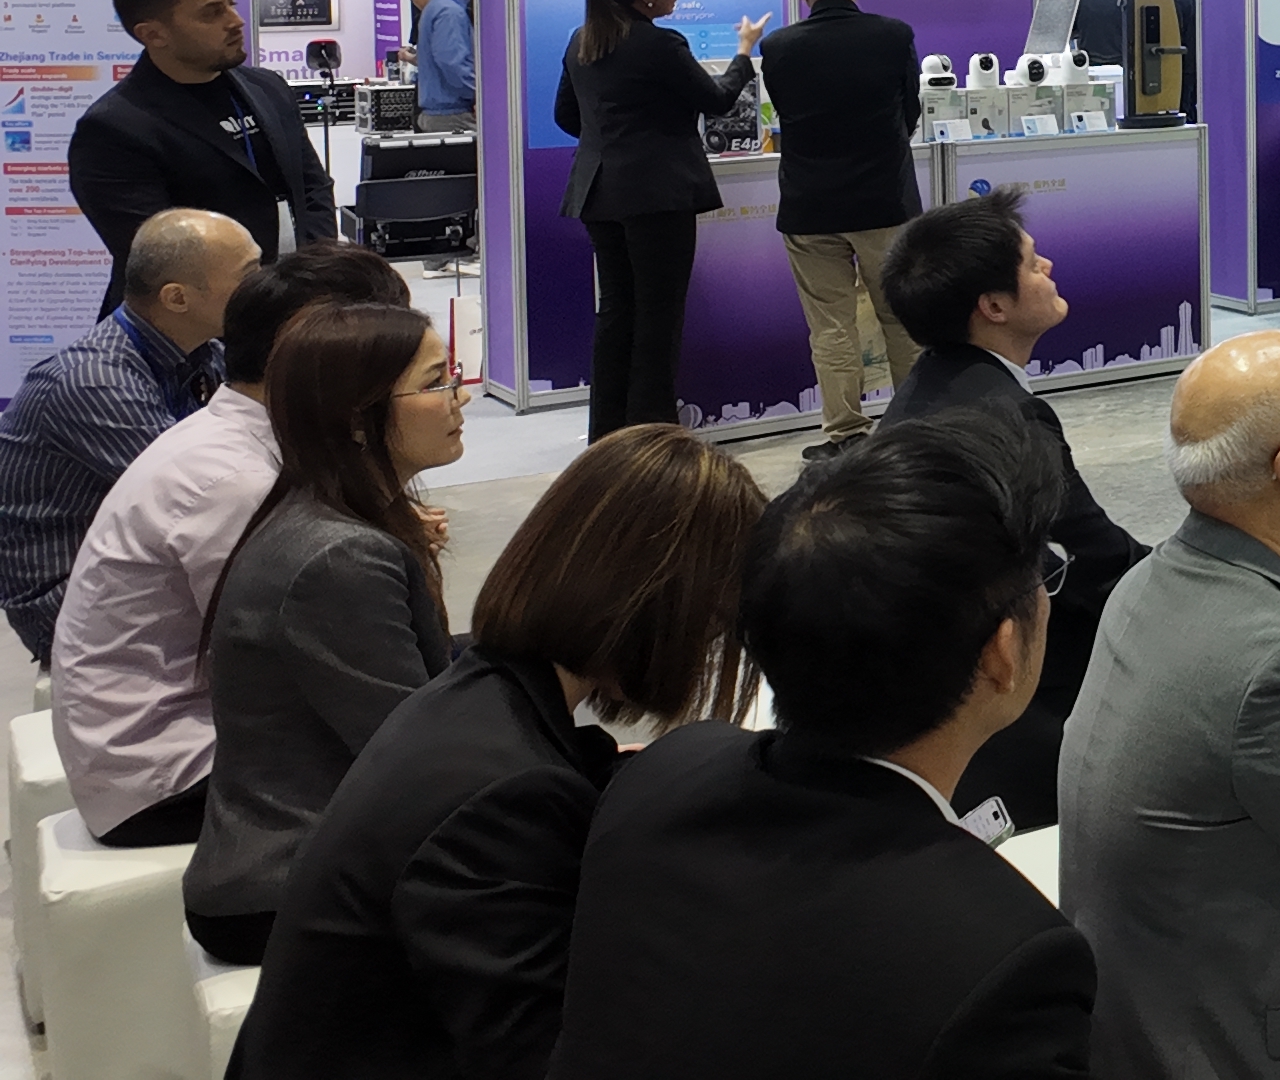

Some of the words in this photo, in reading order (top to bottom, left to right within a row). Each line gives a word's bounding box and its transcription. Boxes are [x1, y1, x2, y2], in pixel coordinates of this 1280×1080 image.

[0, 51, 45, 64] Zhejiang
[48, 51, 81, 61] Trade
[83, 51, 94, 61] in
[257, 47, 304, 63] Sma
